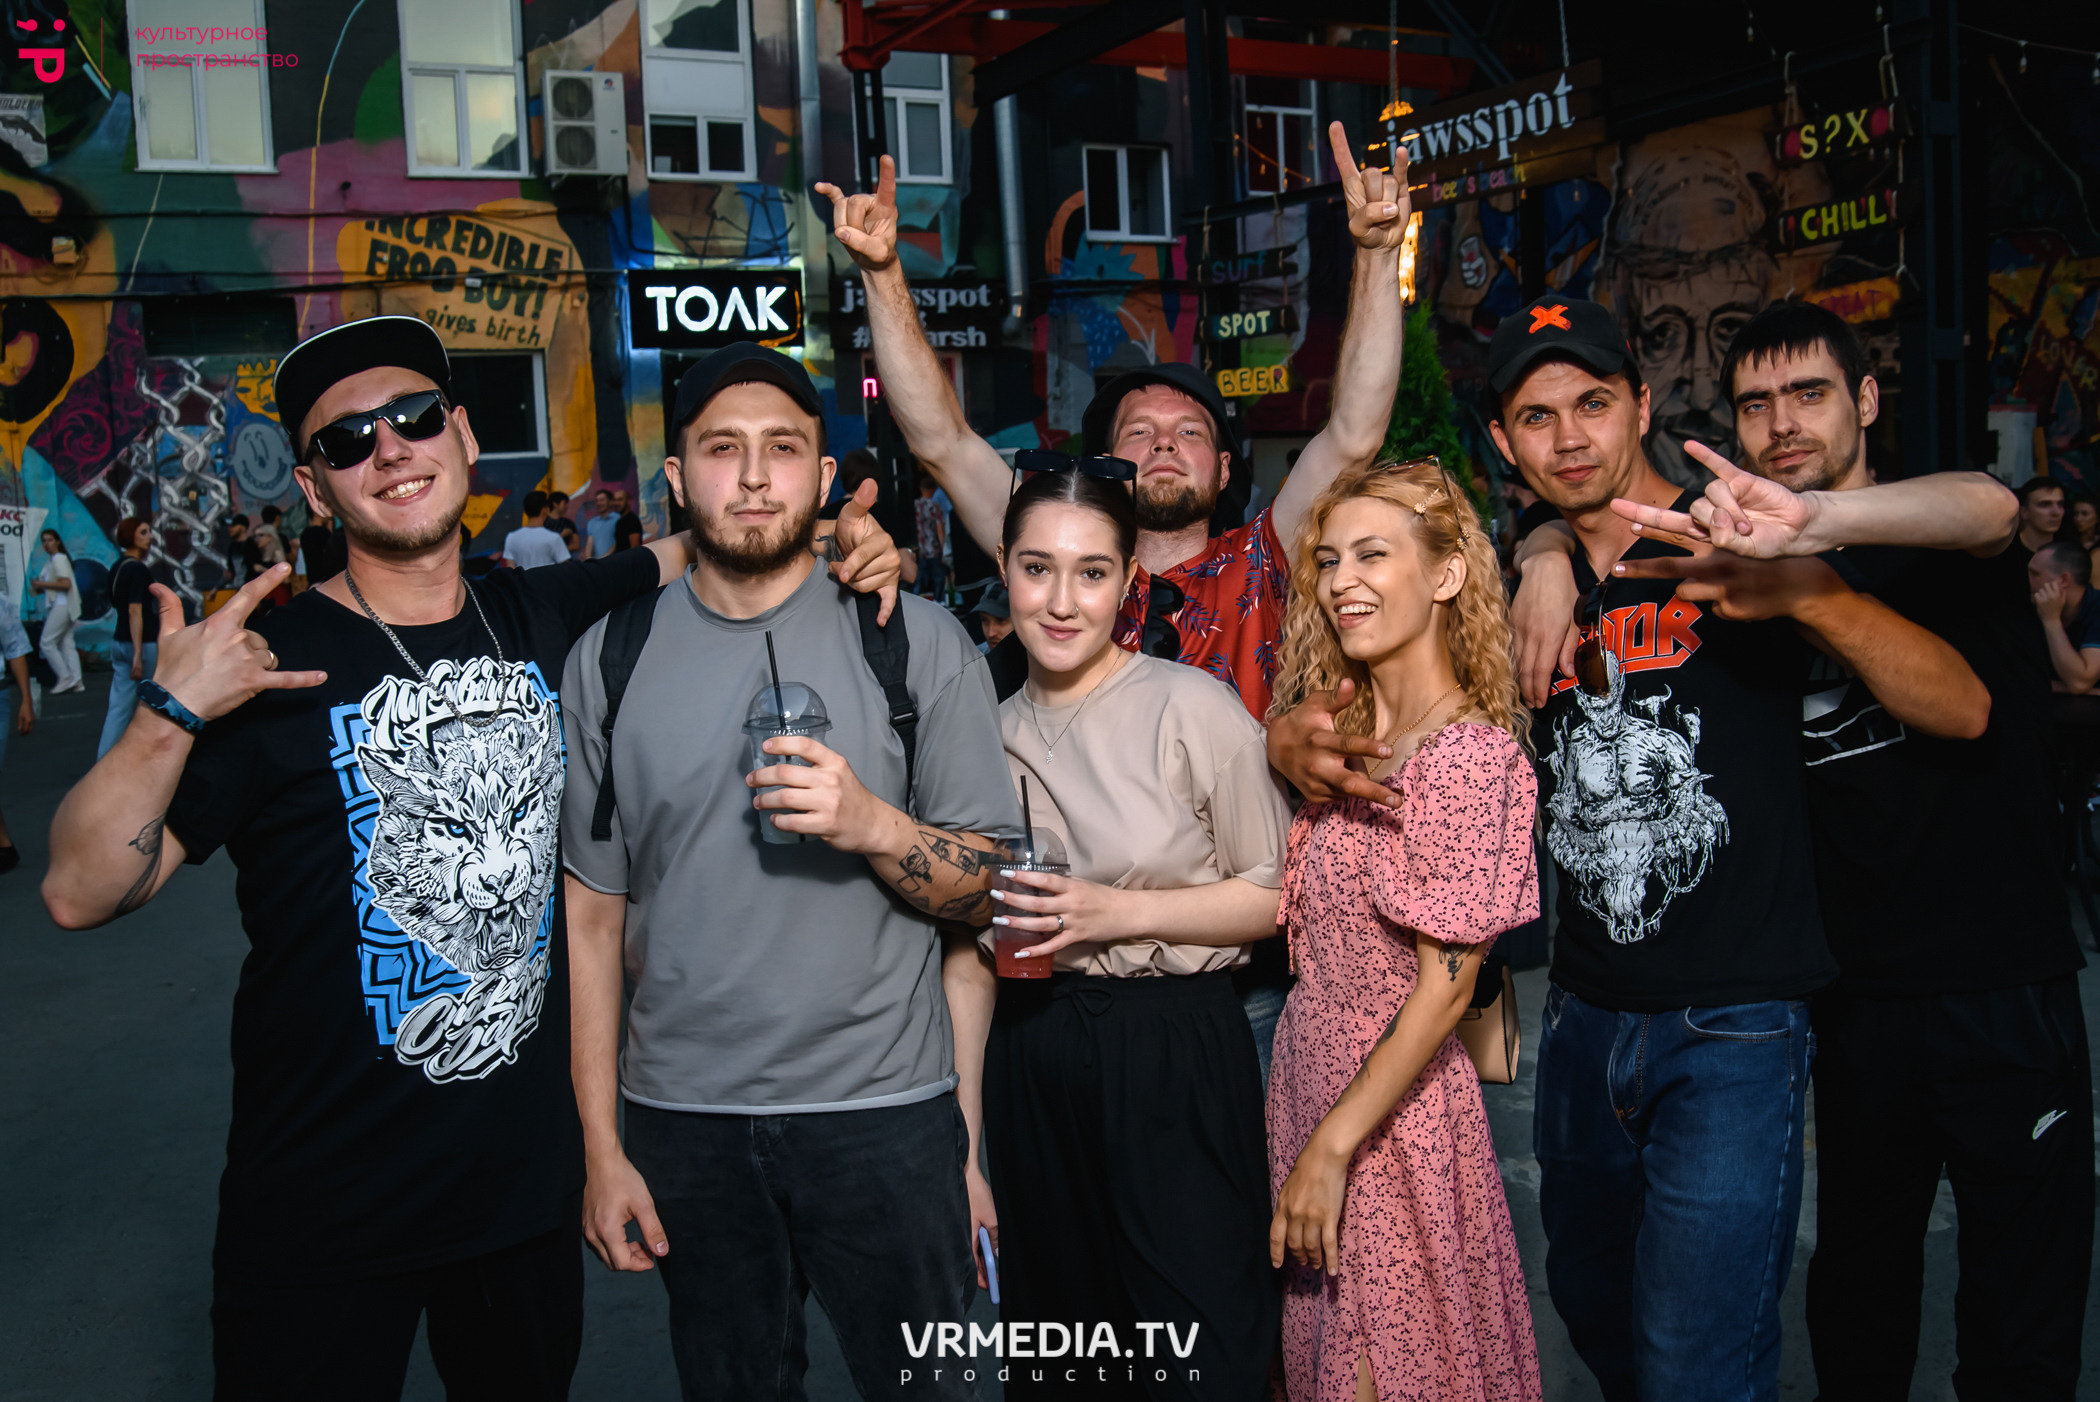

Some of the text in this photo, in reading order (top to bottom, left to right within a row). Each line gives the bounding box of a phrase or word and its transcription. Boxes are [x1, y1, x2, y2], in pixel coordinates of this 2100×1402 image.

[1801, 195, 1887, 240] CHILL
[426, 306, 541, 346] gives birth
[1218, 310, 1271, 338] SPOT
[1221, 367, 1286, 394] BEER
